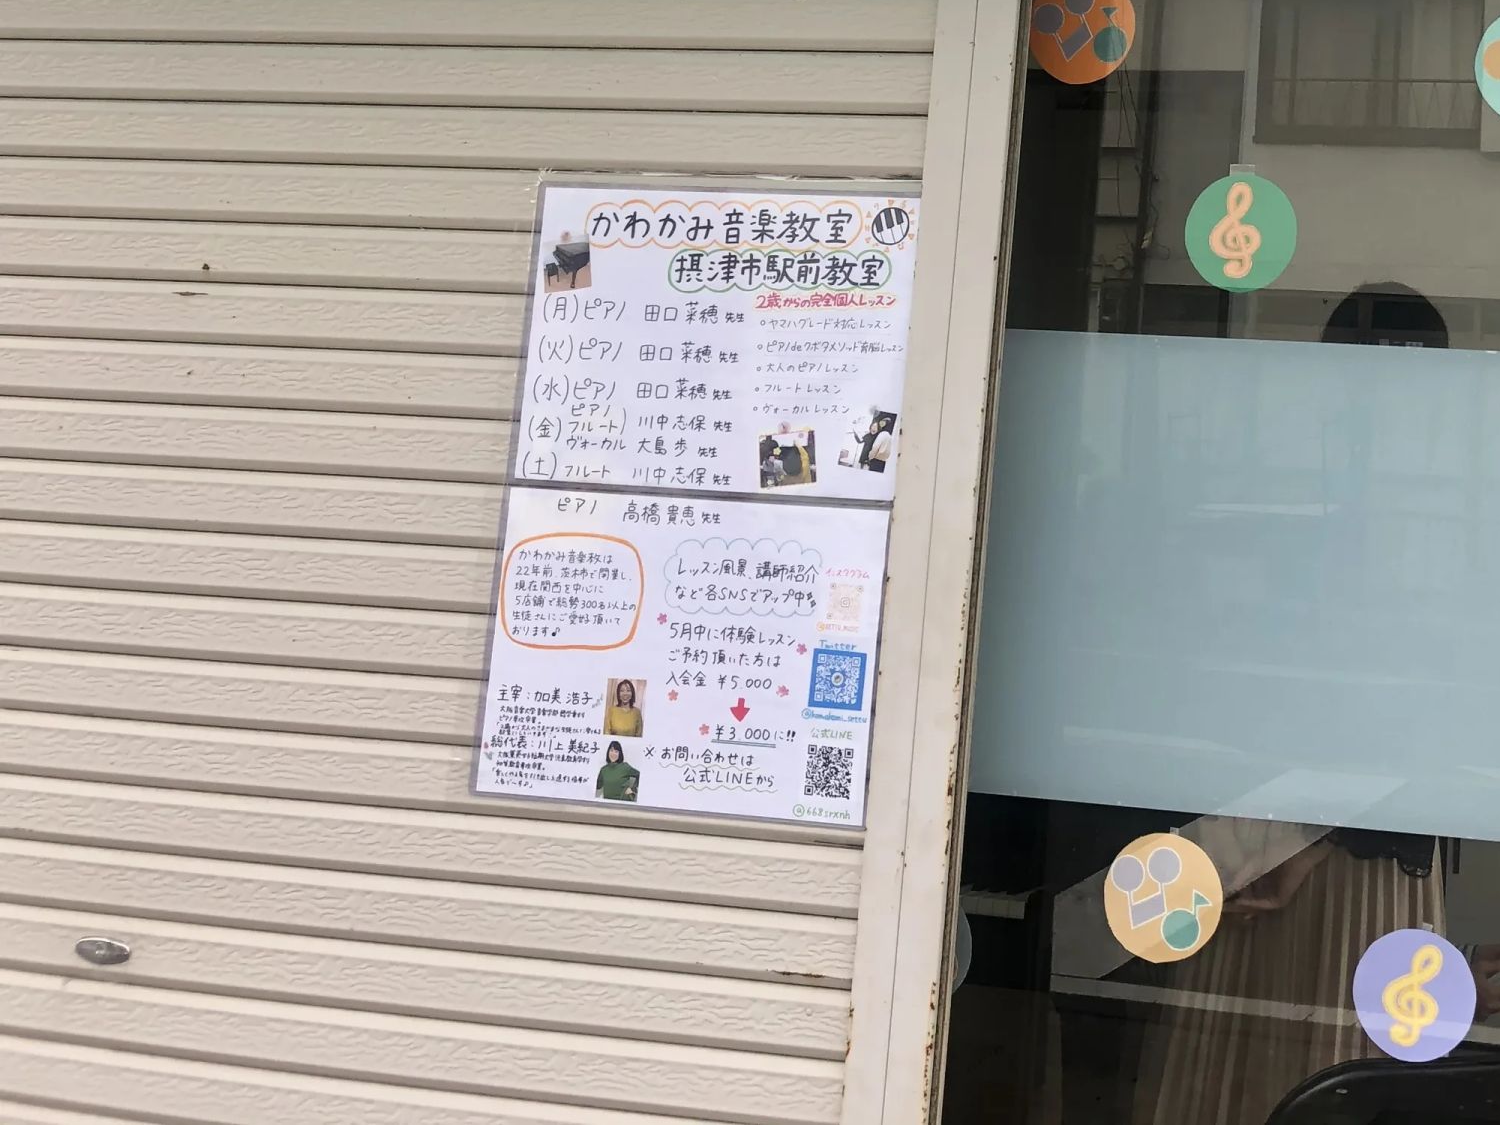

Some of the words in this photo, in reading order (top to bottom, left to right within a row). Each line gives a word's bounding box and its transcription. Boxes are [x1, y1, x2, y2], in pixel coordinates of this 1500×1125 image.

[590, 208, 854, 245] かわかみ音楽教室
[675, 249, 885, 287] 摂津市駅前教室
[756, 293, 896, 308] 2歳からの完全個人レッスン
[725, 312, 744, 323] 先生
[719, 351, 739, 363] 先生
[766, 362, 859, 373] 大人のピアノレッスン
[712, 389, 732, 400] 先生
[571, 404, 611, 417] ピアノ
[638, 415, 706, 431] 川中志保
[713, 420, 733, 432] 先生
[566, 435, 626, 451] ヴォーカル
[698, 446, 718, 458] 先生
[632, 467, 707, 485] 川中志保
[712, 475, 732, 486] 先生
[557, 497, 597, 514] ピアノ
[701, 512, 721, 524] 先生
[669, 622, 796, 647] 5月中に体験レッスン
[667, 648, 781, 667] ご予約頂いた方は
[666, 669, 707, 688] 入会金
[811, 728, 853, 740] 公式LINE
[683, 767, 774, 787] 公式LINEから
